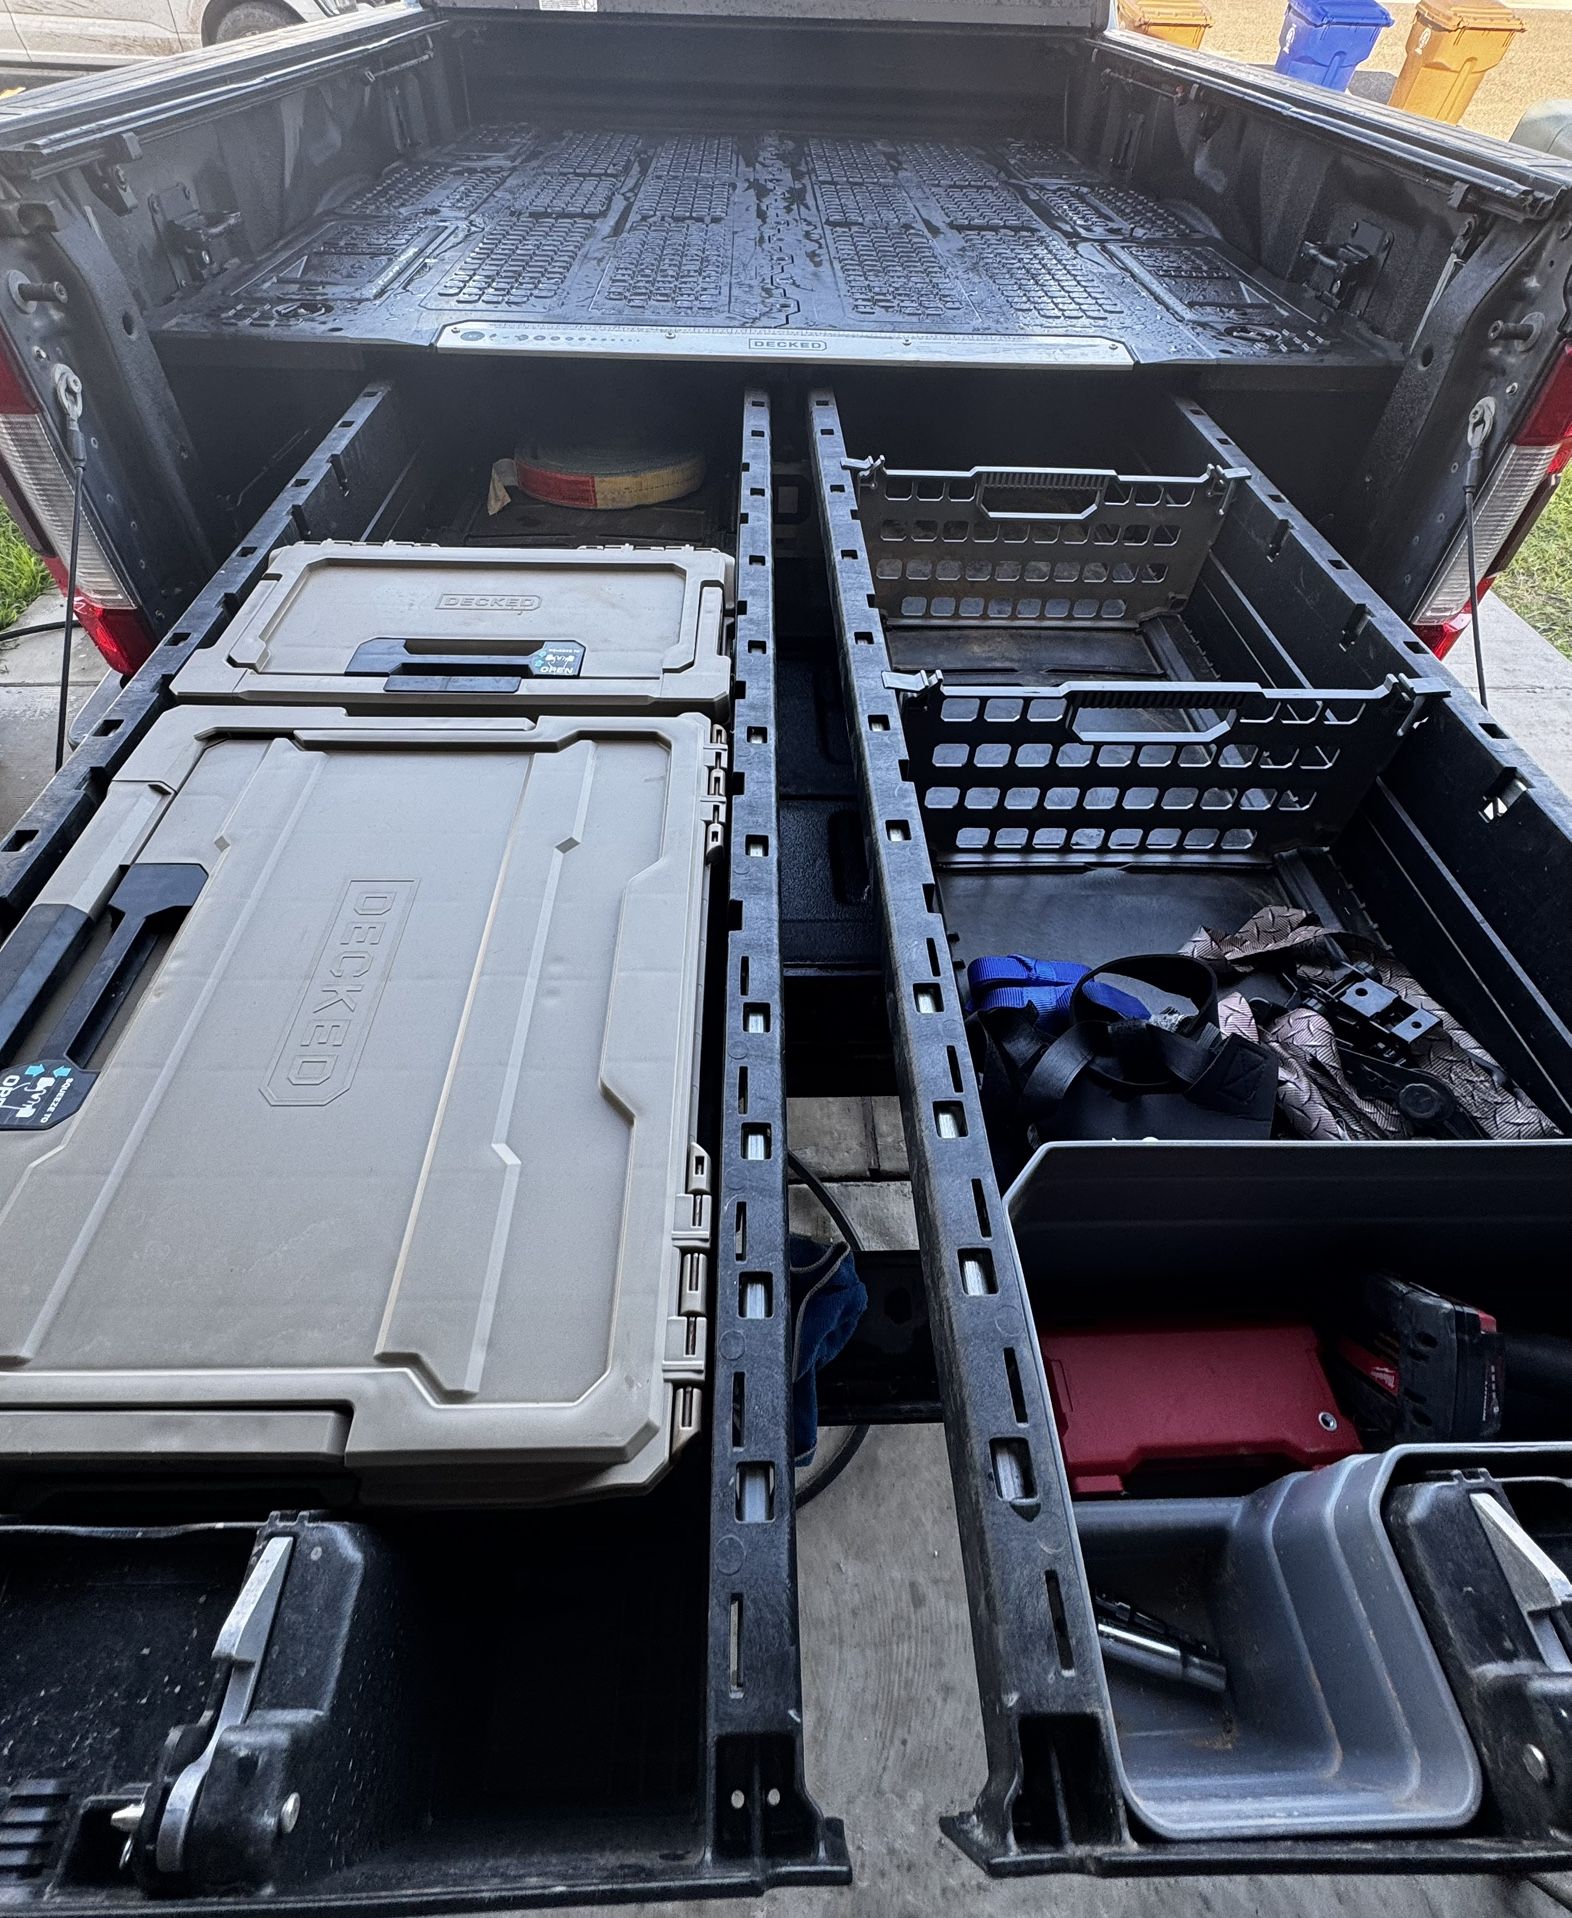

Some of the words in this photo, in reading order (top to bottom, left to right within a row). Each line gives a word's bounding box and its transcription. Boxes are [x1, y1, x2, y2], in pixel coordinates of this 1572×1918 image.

[444, 598, 535, 607] DECKED
[541, 666, 573, 674] OPEN
[286, 891, 397, 1086] DECKED
[47, 1077, 74, 1112] SQUEEZE
[40, 1113, 52, 1123] TO
